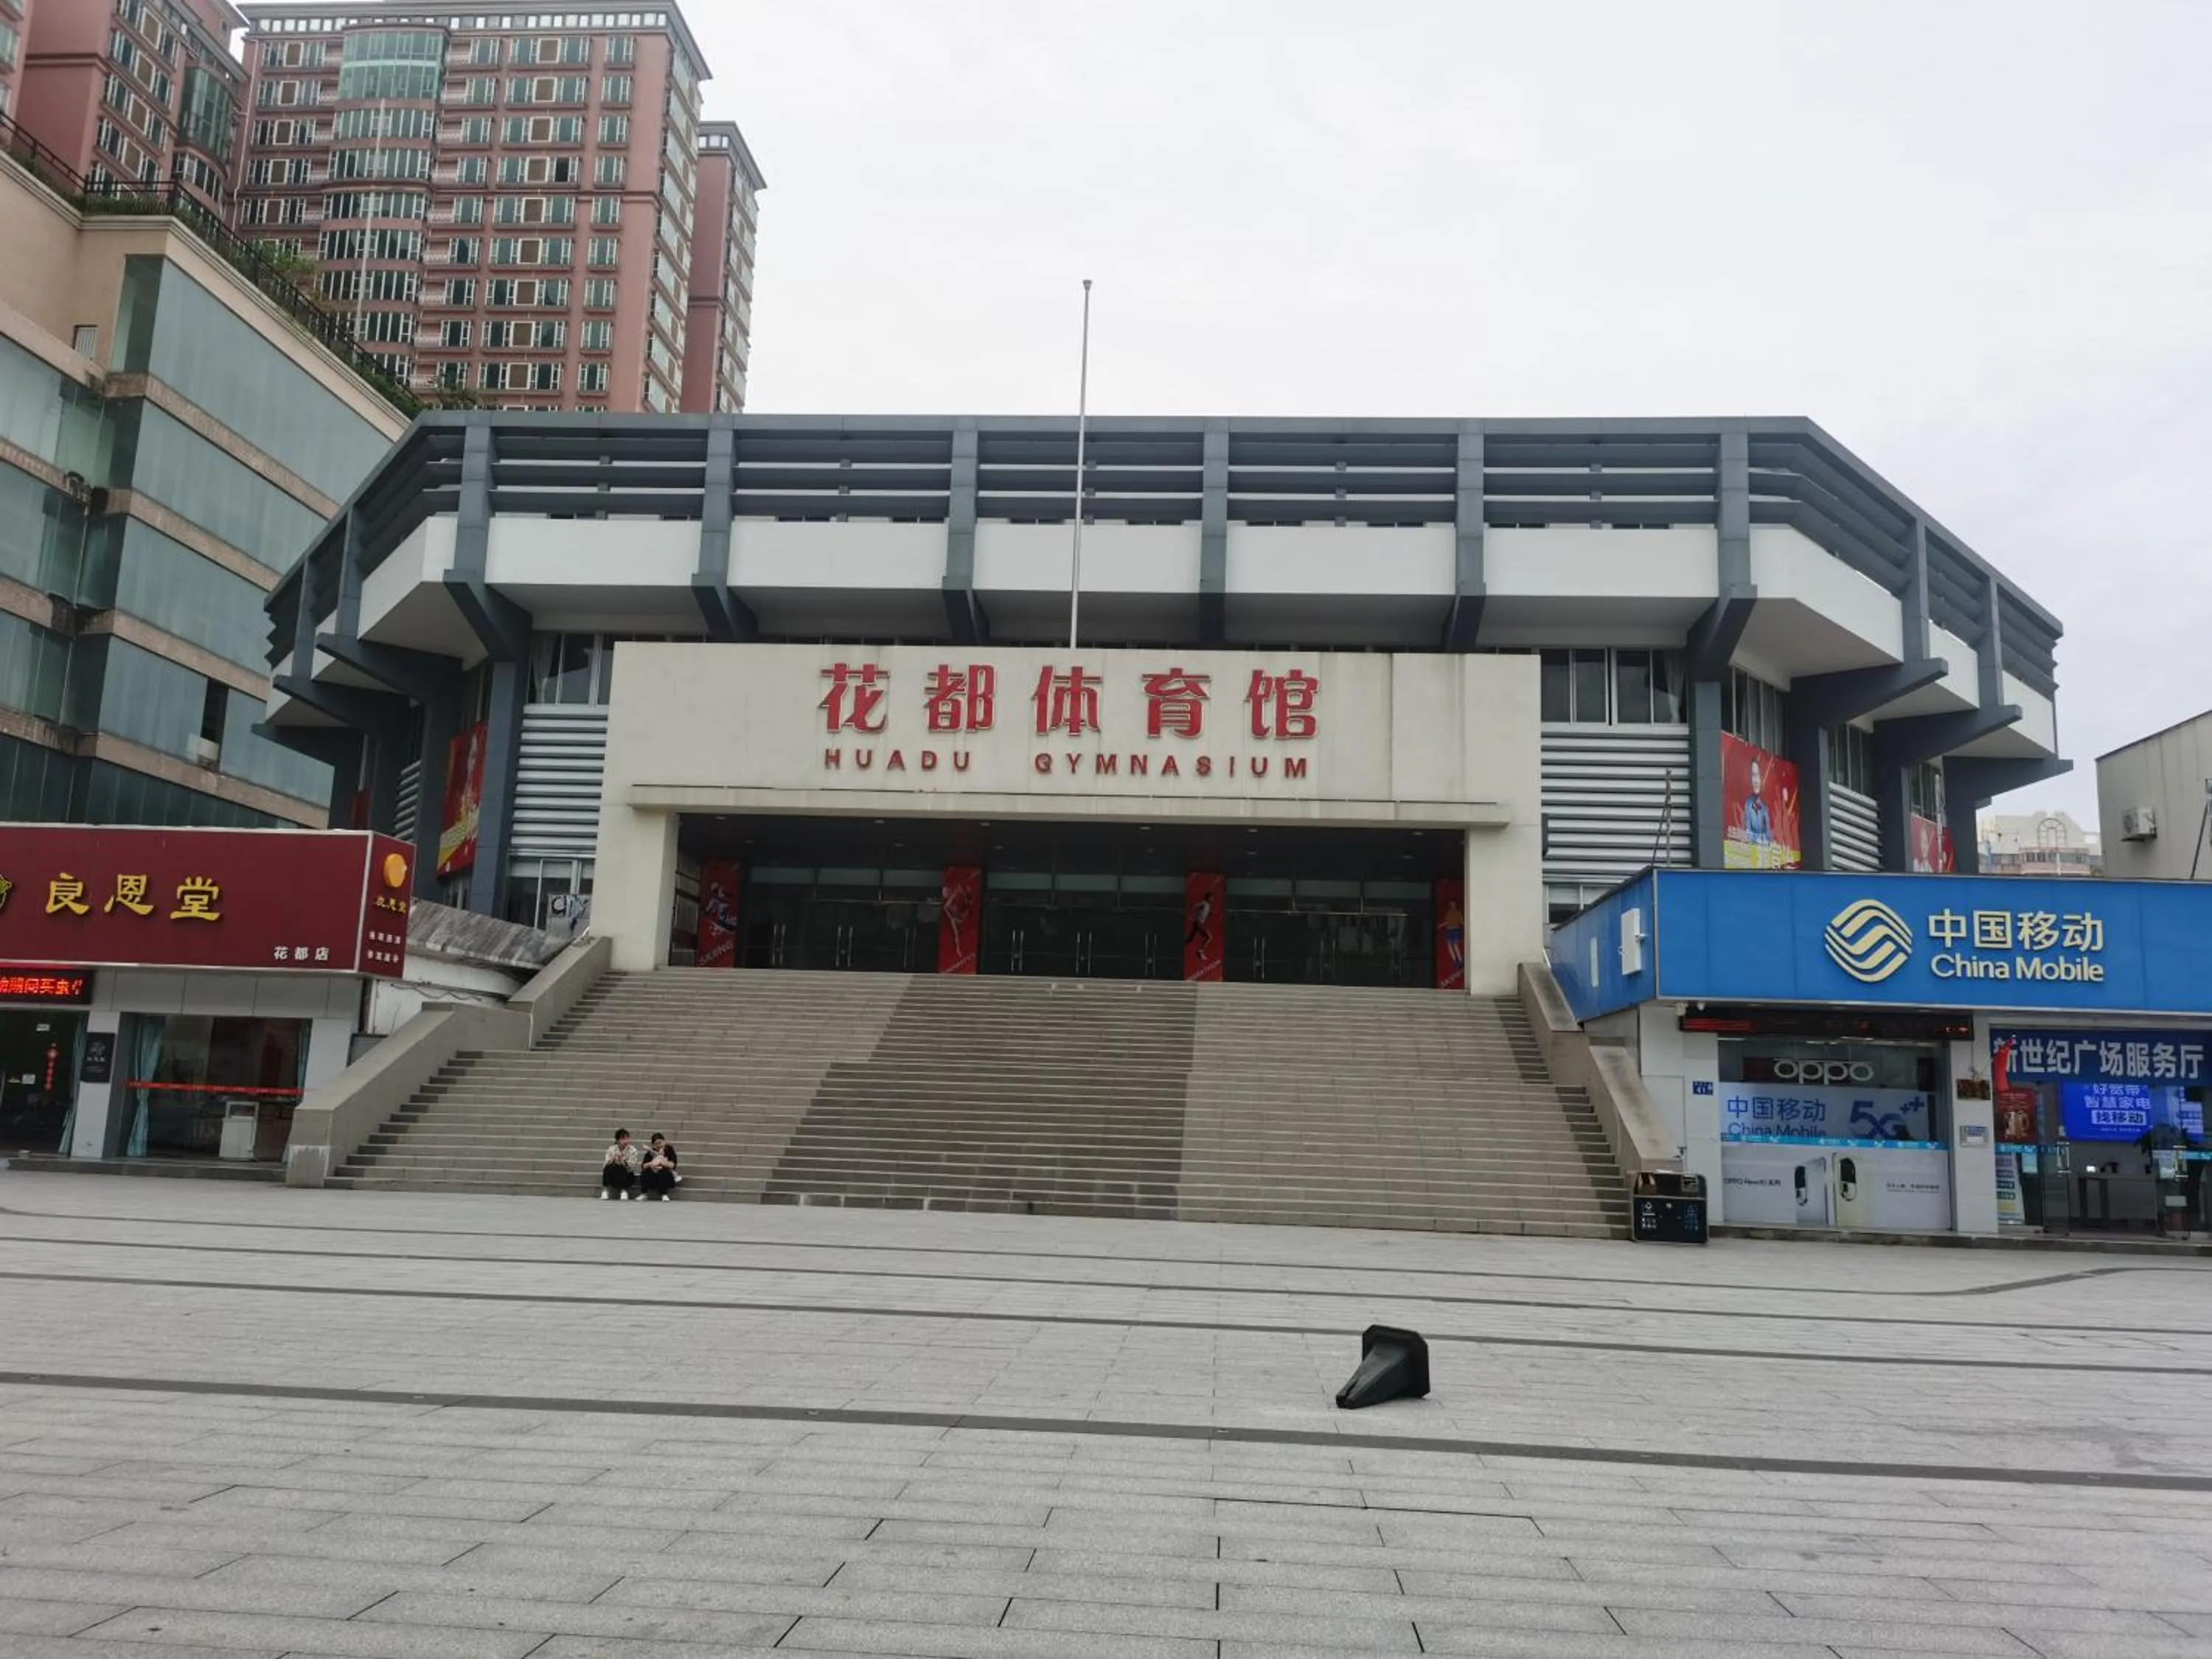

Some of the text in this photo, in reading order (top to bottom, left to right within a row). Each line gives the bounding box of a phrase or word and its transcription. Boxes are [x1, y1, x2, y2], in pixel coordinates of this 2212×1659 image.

[818, 663, 1320, 741] 花都体育馆
[824, 748, 1308, 779] HUADU GYMNASIUM
[45, 872, 220, 922] 良恩堂
[1928, 908, 2104, 953] 中国移动
[274, 945, 330, 961] 花都店
[1930, 953, 2105, 982] China Mobile
[1728, 1095, 1826, 1122] 中国移动
[2084, 1095, 2152, 1110] 智慧家电
[1728, 1121, 1770, 1138] China
[2097, 1111, 2145, 1124] 找移动
